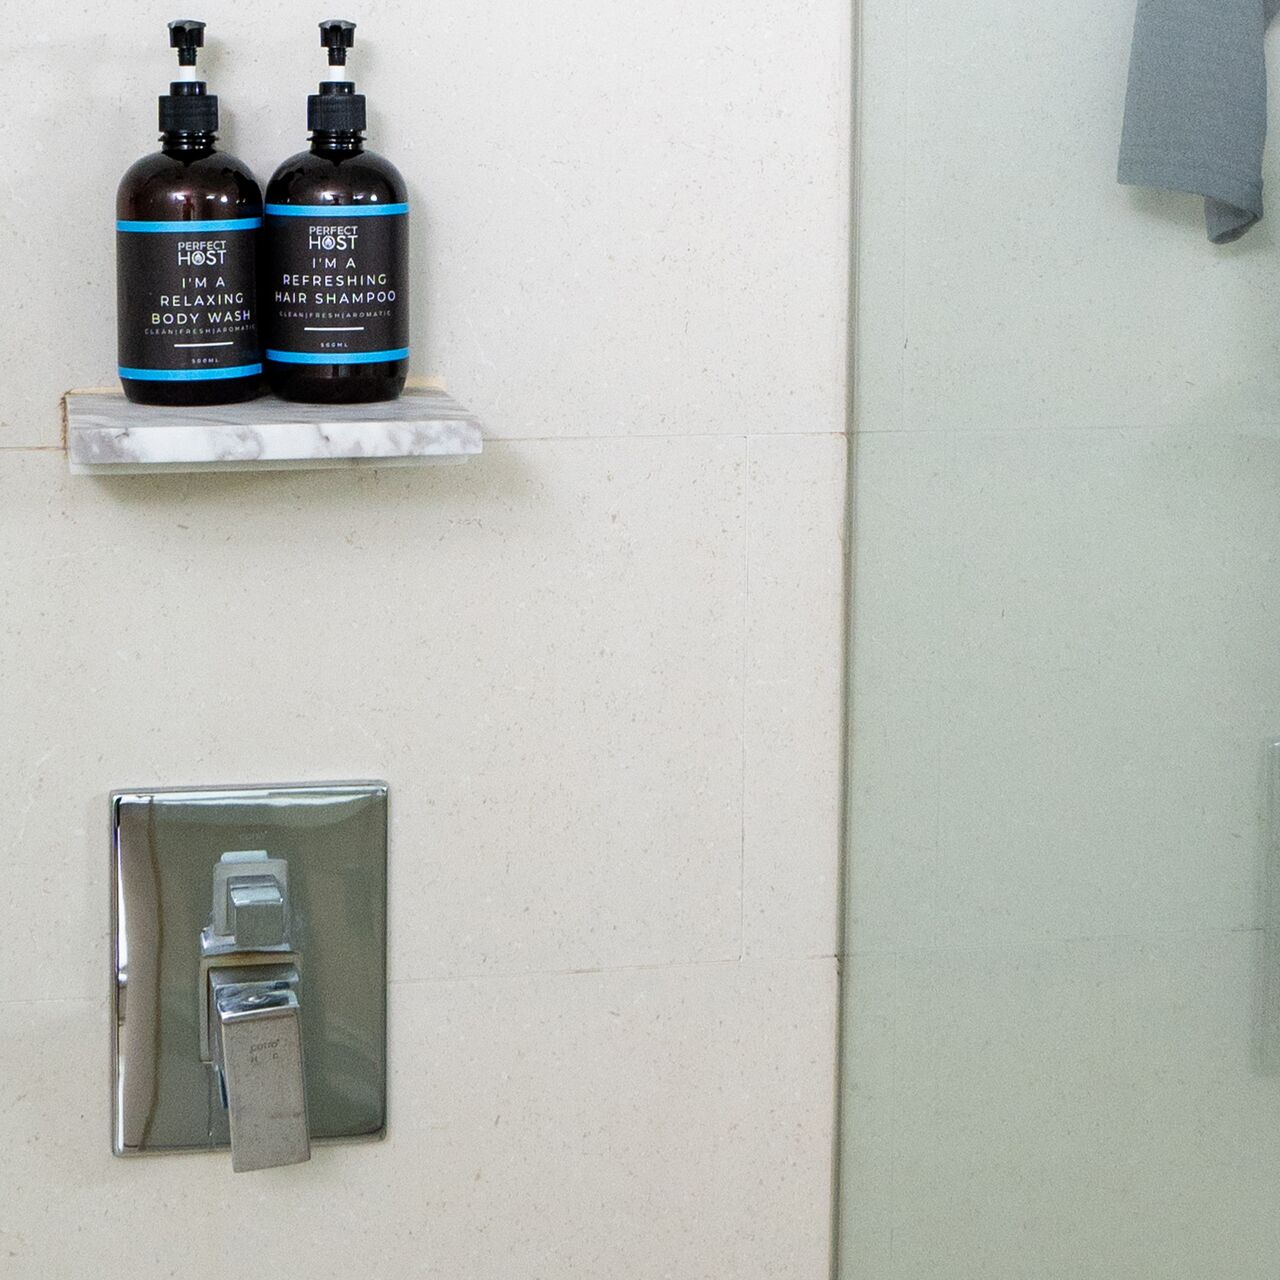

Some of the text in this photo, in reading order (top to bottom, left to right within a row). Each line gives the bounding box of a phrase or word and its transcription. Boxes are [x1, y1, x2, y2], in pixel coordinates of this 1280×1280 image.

[307, 225, 358, 235] PERFECT
[177, 240, 227, 251] PERFECT
[309, 235, 358, 250] HOST
[177, 250, 227, 266] HOST
[312, 257, 356, 269] I'M A
[182, 276, 226, 289] I'M A
[282, 273, 387, 287] REFRESHING
[160, 292, 244, 307] RELAXING
[275, 290, 396, 305] HAIR SHAMPOO
[151, 309, 251, 325] BODY WASH
